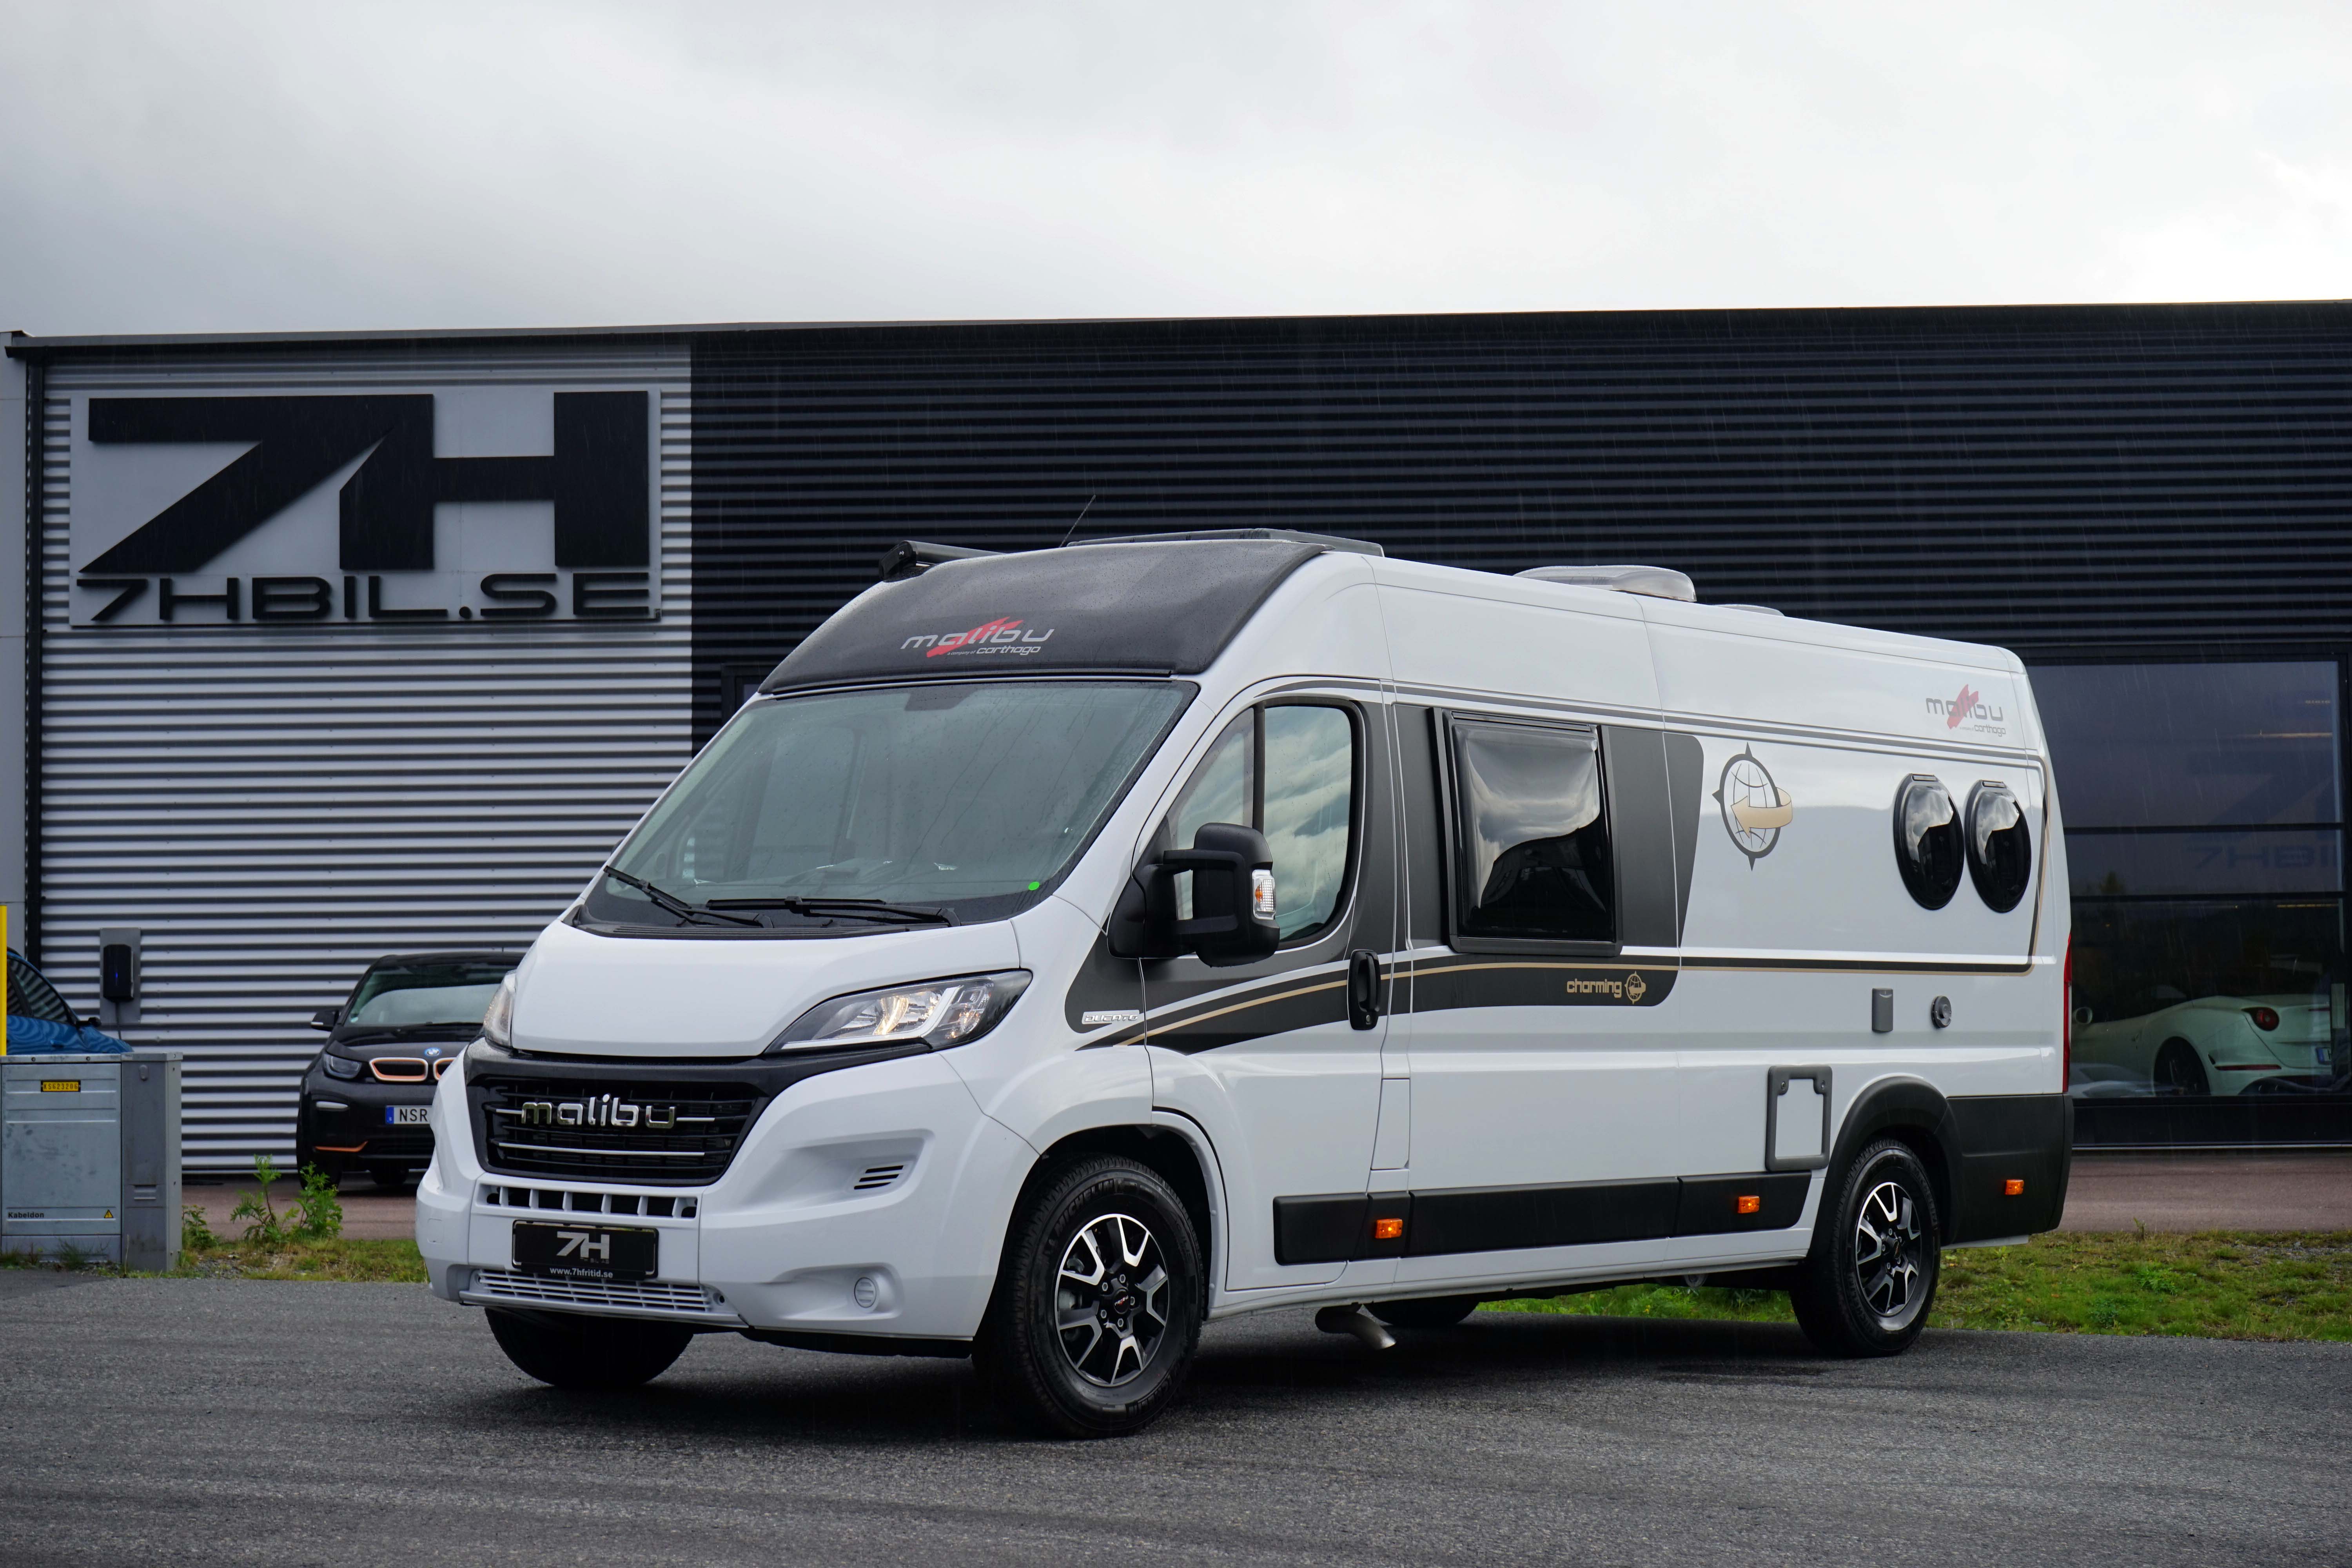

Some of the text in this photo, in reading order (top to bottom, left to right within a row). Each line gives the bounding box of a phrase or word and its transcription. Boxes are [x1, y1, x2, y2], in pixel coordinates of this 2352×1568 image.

[78, 391, 649, 573] 7H
[76, 573, 649, 621] 7HBIL.SE
[900, 626, 1054, 649] malibu
[976, 645, 1041, 655] carthago
[1926, 695, 2003, 721] malibu
[1974, 724, 2006, 737] carthago
[1567, 978, 1622, 998] charming
[399, 1109, 428, 1122] NSR
[521, 1094, 676, 1129] malibu
[557, 1231, 610, 1259] 7H
[550, 1268, 613, 1278] www.7hfritid.se
